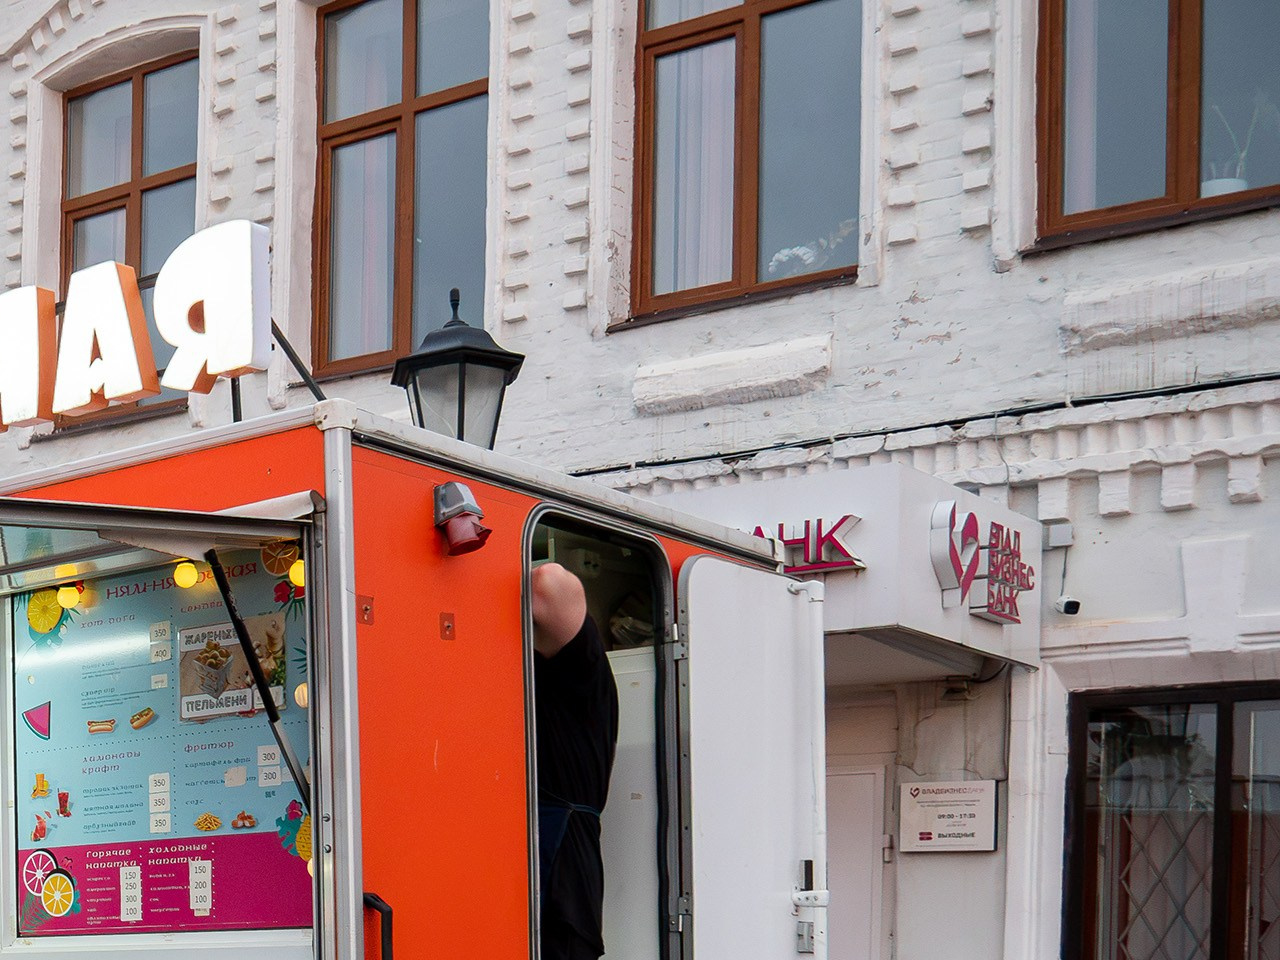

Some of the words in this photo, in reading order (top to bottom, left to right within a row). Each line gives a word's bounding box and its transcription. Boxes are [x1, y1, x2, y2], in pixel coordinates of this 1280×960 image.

[989, 521, 1021, 561] ВЛАД
[988, 549, 1035, 591] БИЗНЕС
[987, 579, 1021, 617] БАНК
[154, 628, 167, 638] 350
[154, 649, 167, 658] 400
[185, 694, 248, 713] ПЕЛЬМЕНИ
[82, 751, 141, 763] лимонады
[262, 752, 276, 762] 300
[82, 764, 120, 775] крафт
[263, 771, 277, 781] 300
[153, 778, 166, 788] 350
[153, 798, 166, 807] 350
[154, 819, 167, 828] 350
[937, 832, 976, 840] ВЫХОДНЫЕ
[86, 848, 132, 859] горячие
[148, 843, 208, 854] холодные
[85, 859, 137, 870] напитки
[194, 866, 207, 874] 150
[124, 872, 137, 880] 150
[124, 882, 137, 890] 250
[194, 881, 207, 889] 200
[125, 895, 138, 903] 300
[194, 895, 208, 904] 100
[125, 907, 138, 916] 100
